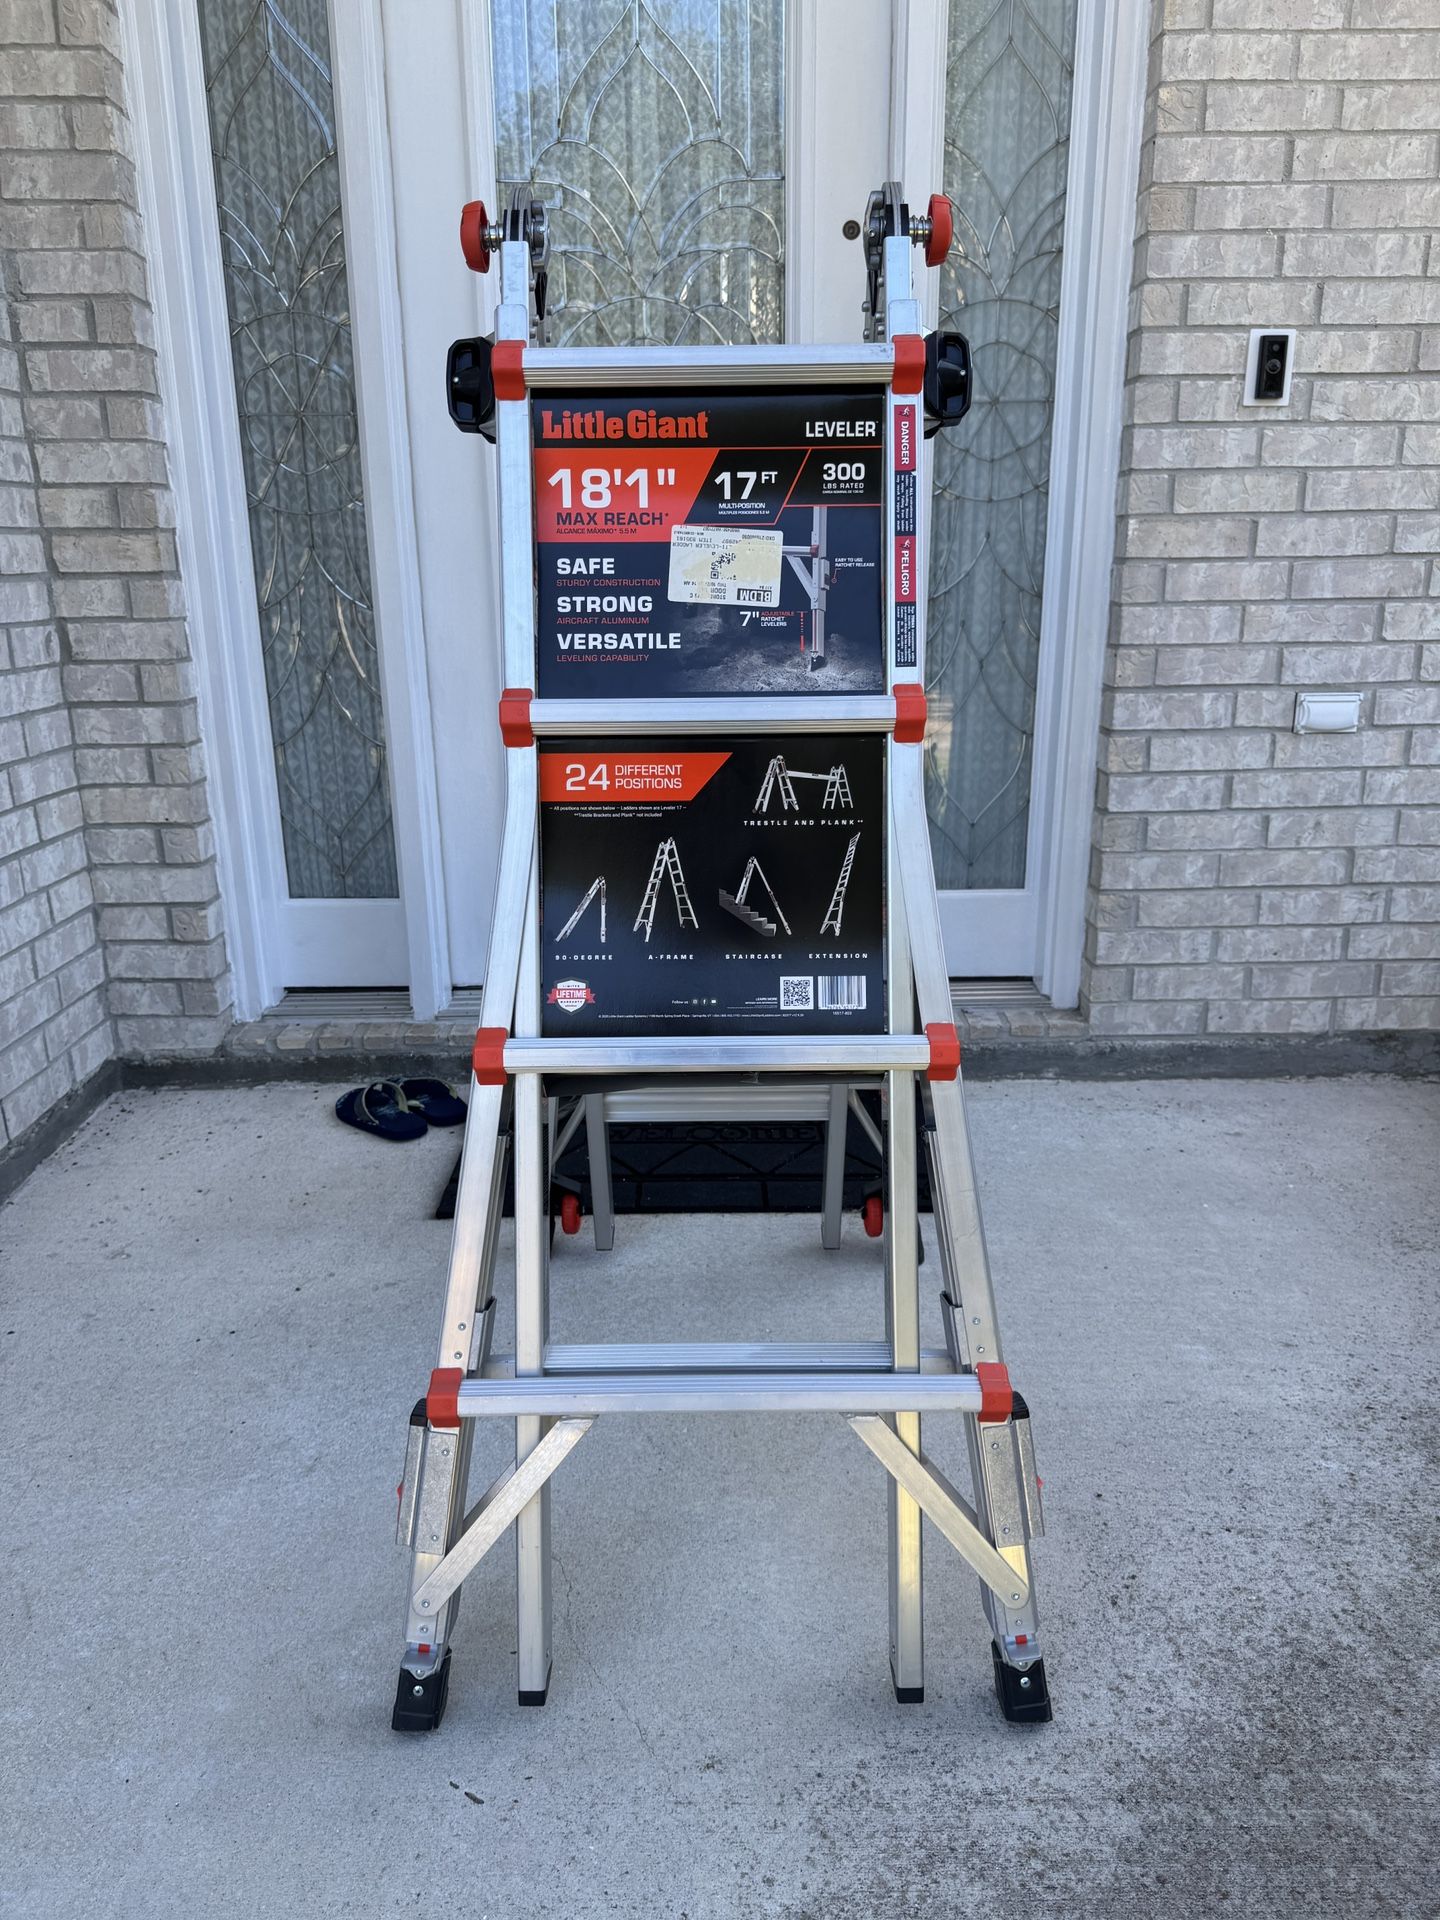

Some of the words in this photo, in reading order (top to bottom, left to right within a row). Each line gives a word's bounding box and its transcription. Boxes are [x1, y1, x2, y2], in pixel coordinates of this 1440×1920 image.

[542, 410, 624, 439] Little
[627, 409, 709, 439] Giant
[805, 421, 877, 437] LEVELER
[901, 421, 909, 465] DANGER
[823, 463, 866, 481] 300
[547, 468, 676, 509] 18'1"
[714, 471, 757, 500] 17
[761, 471, 778, 484] FT
[556, 512, 598, 526] MAX
[556, 558, 615, 575] SAFE
[901, 550, 909, 596] PELIGRO
[556, 579, 591, 587] STURDY
[593, 578, 661, 587] CONSTRUCTION
[739, 589, 772, 602] BLDM
[556, 596, 653, 613] STRONG
[556, 632, 682, 650] VERSATILE
[556, 654, 598, 662] LEVELING
[599, 654, 649, 662] CAPABILITY
[565, 763, 610, 791] 24
[615, 764, 683, 776] DIFFERENT
[615, 777, 682, 789] POSITIONS
[556, 989, 587, 998] LIFETIME
